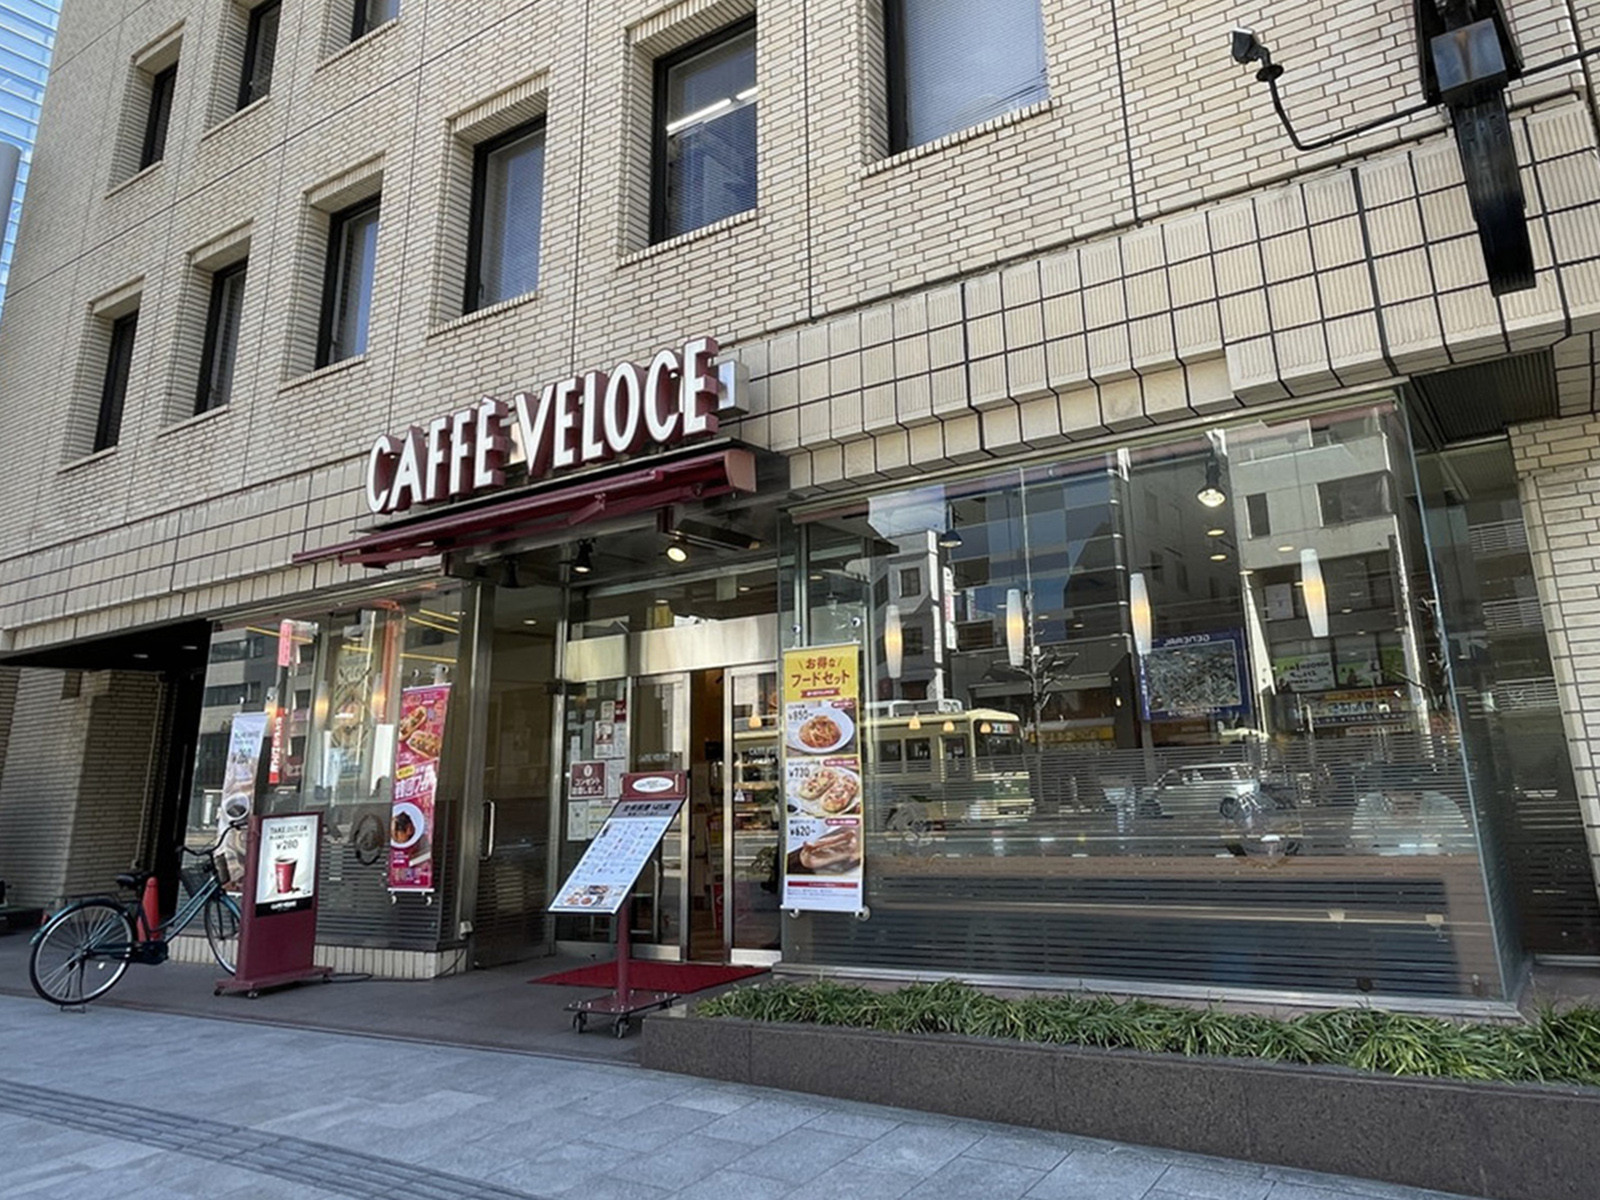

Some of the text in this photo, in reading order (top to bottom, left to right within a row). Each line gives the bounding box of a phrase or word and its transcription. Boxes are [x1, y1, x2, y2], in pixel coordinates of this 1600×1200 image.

[515, 336, 718, 477] VELOCE
[805, 656, 836, 669] お得な
[791, 669, 851, 688] フードセット
